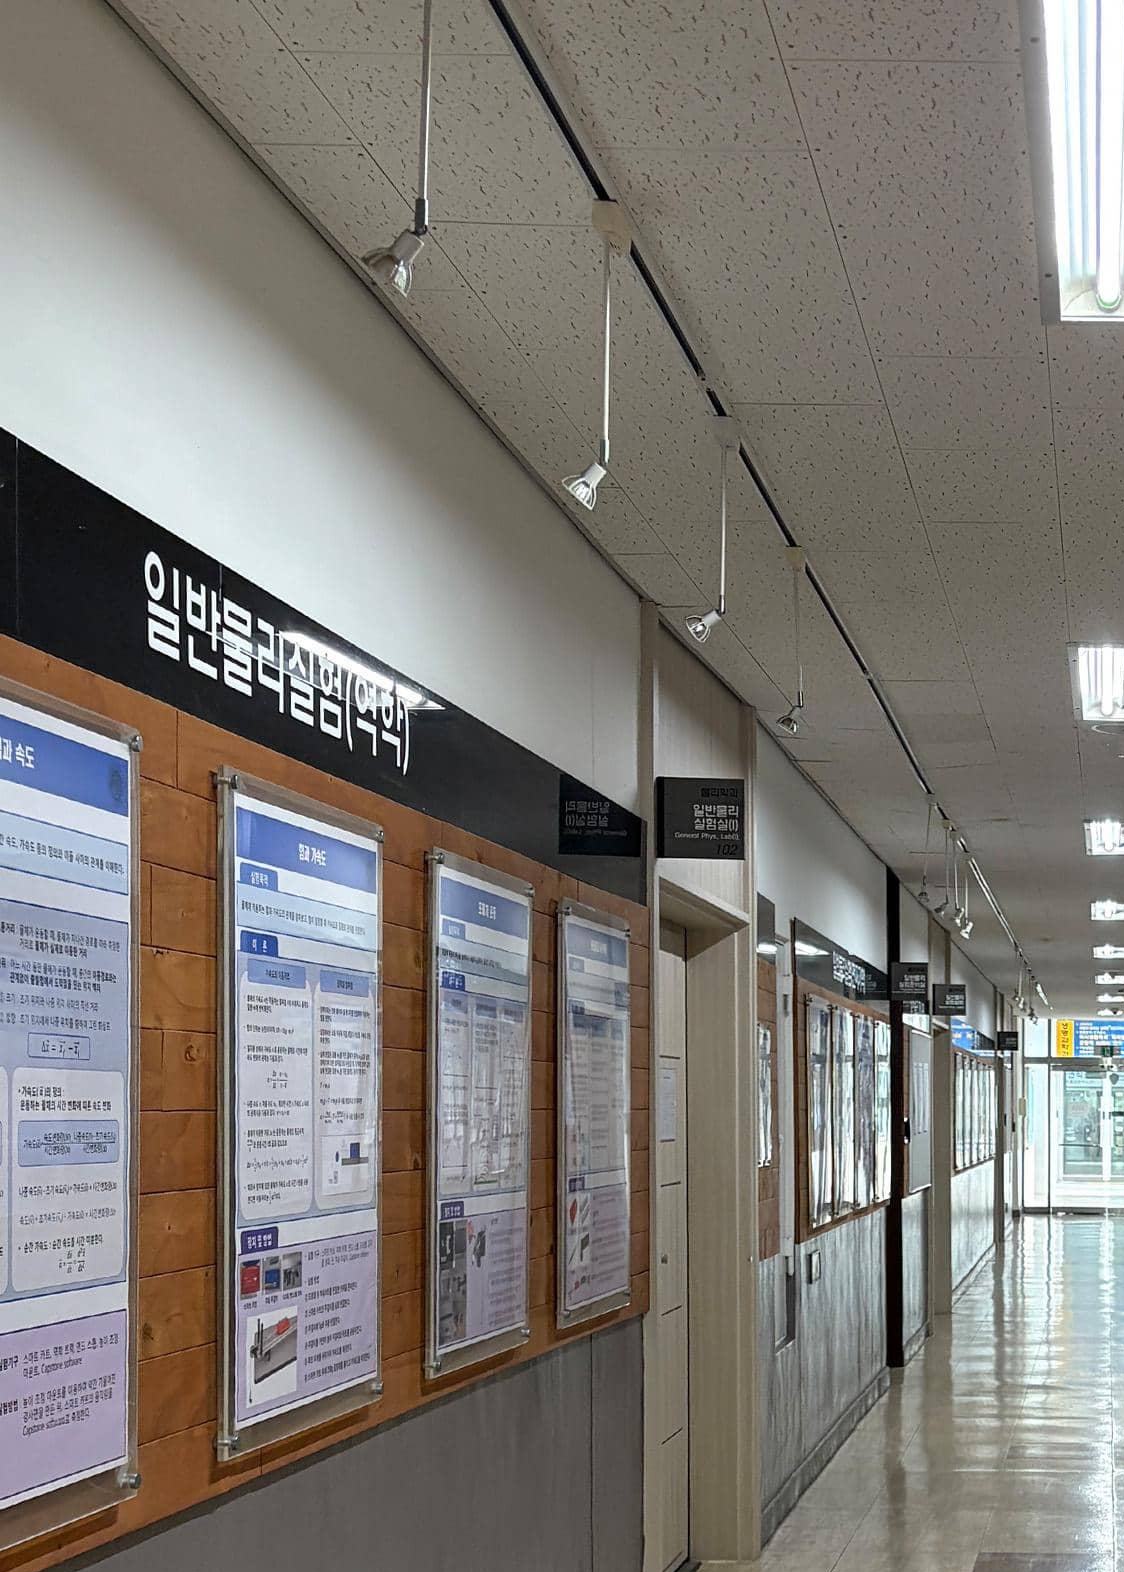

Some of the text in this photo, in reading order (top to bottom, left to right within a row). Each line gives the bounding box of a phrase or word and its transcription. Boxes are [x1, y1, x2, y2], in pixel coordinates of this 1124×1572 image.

[144, 551, 410, 776] 일반물리실험(역학)
[16, 743, 35, 769] 속도
[693, 804, 739, 818] 일반물리
[694, 818, 738, 832] 실험실(I)
[311, 847, 326, 867] 가속도
[716, 844, 738, 856] 102
